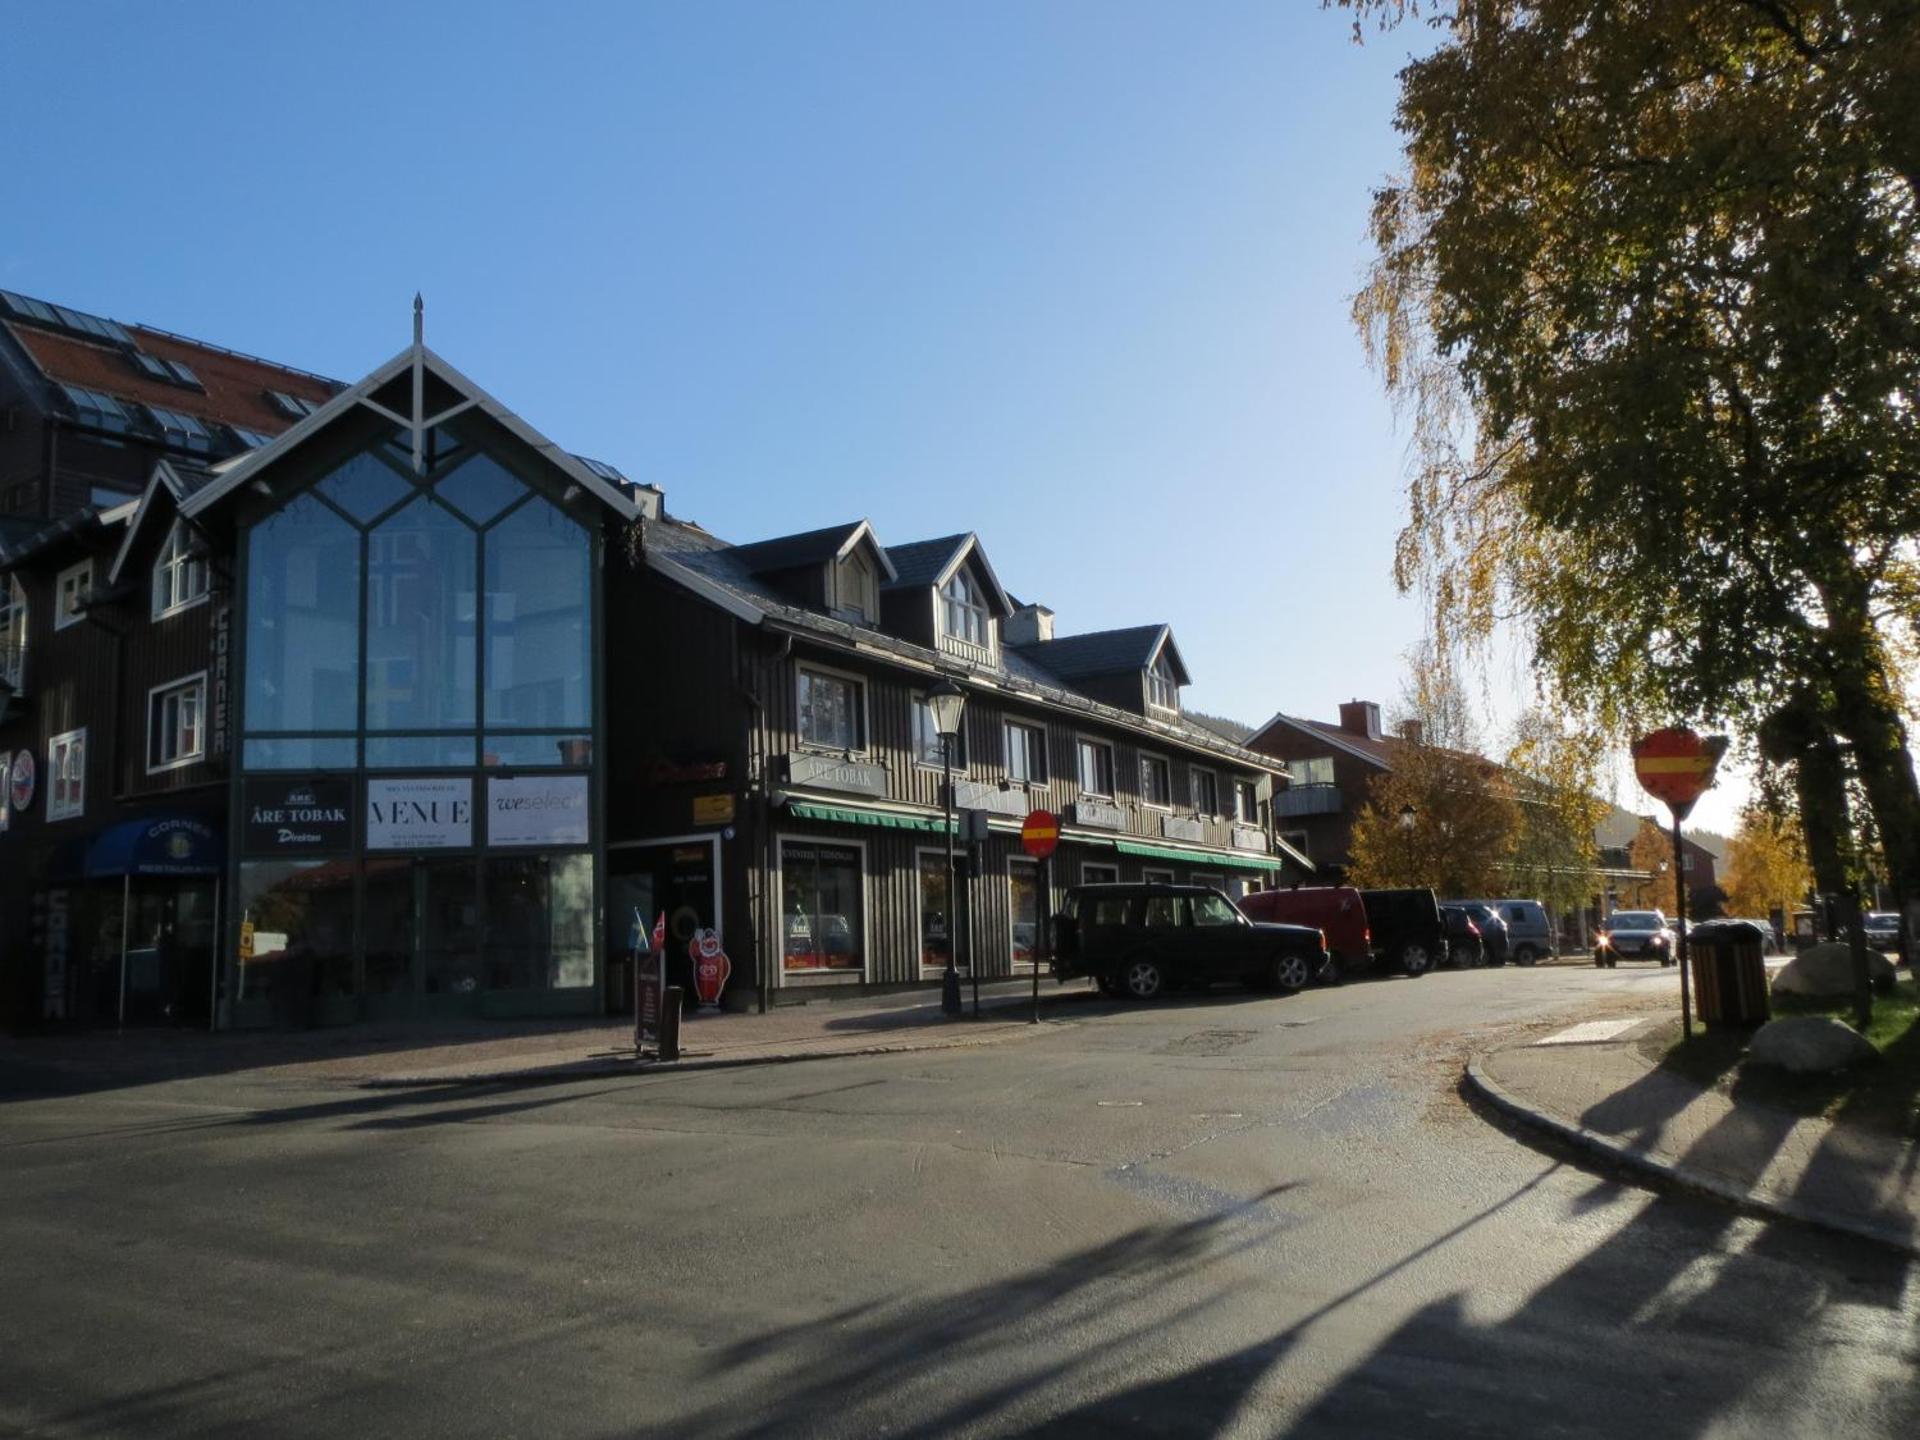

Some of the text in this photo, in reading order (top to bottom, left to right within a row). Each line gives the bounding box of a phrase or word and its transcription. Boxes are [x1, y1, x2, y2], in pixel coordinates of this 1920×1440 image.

[836, 765, 871, 787] TOBAK
[496, 789, 577, 811] weselec
[250, 803, 347, 824] ÅRE TOBAK
[369, 801, 470, 824] VENUE
